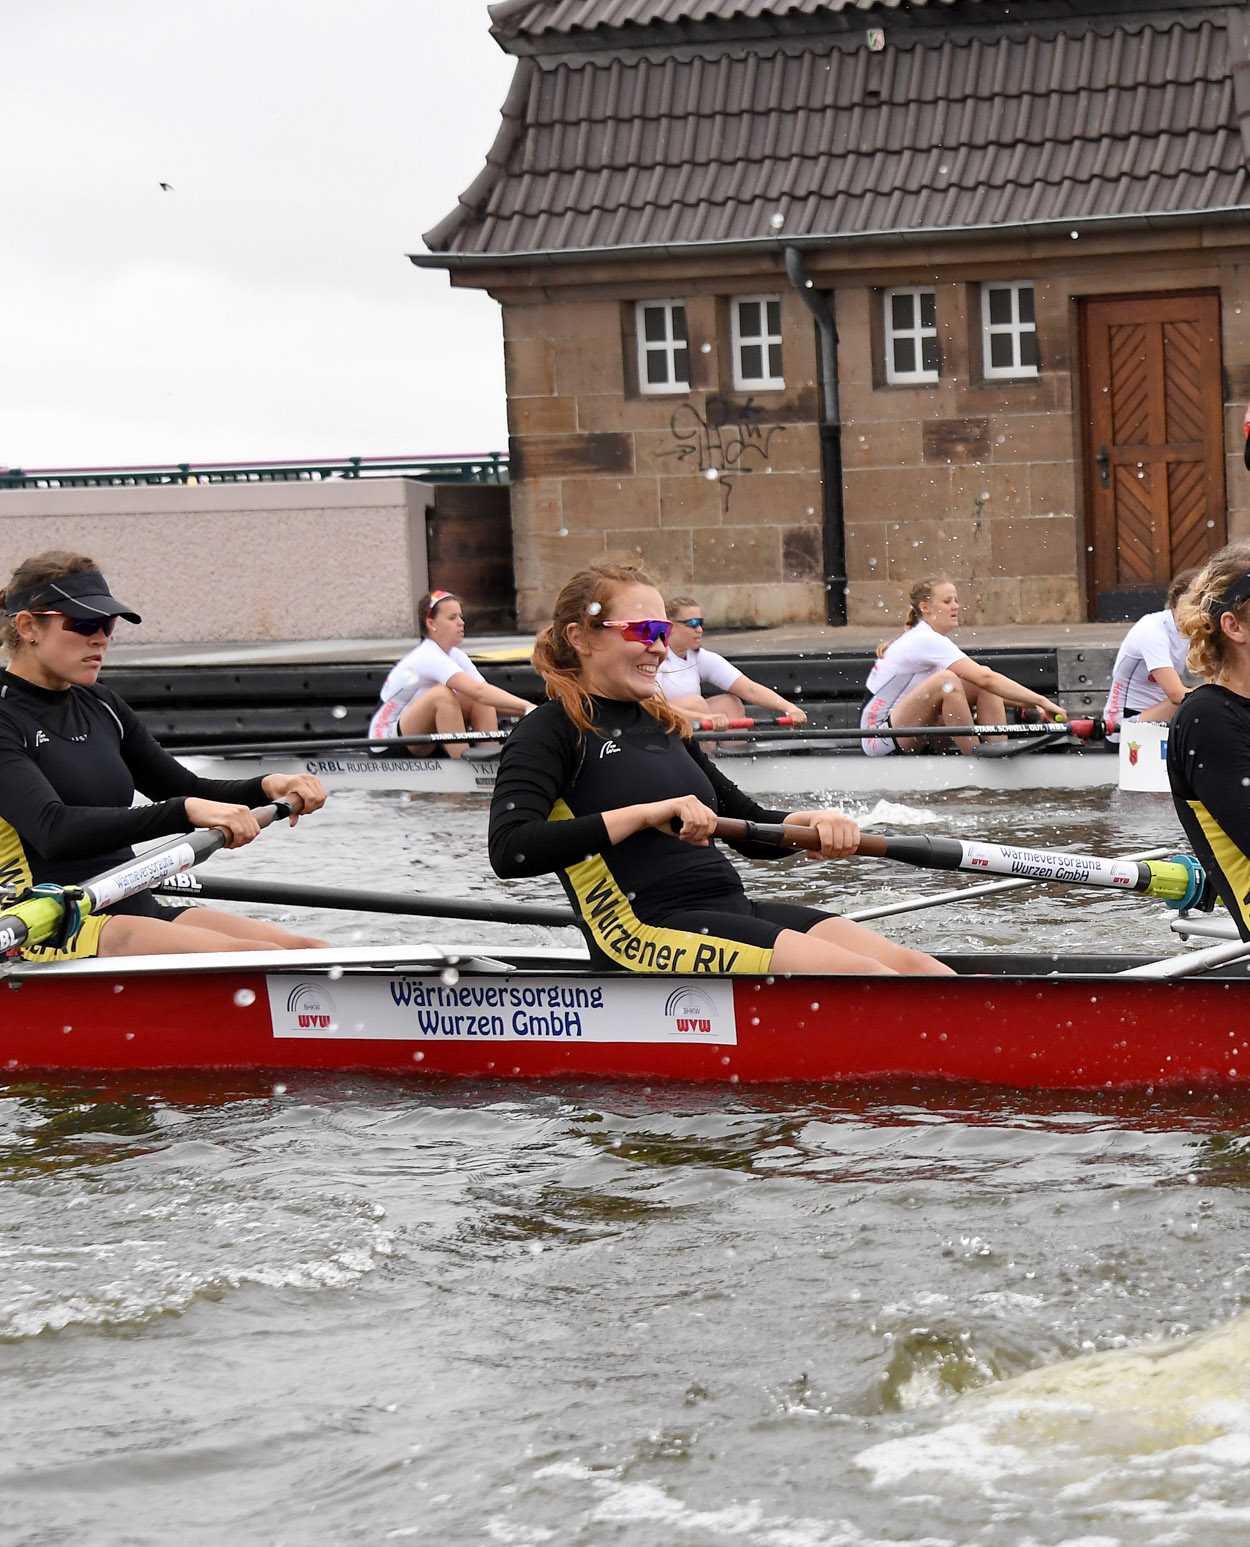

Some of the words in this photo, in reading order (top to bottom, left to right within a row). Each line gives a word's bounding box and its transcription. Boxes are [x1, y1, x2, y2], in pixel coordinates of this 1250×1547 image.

[974, 724, 998, 733] STARK.
[999, 724, 1029, 732] SCHNELL.
[1029, 723, 1046, 731] GUT.
[319, 761, 345, 772] RBL
[347, 760, 443, 773] RUDER-BUNDESLIGA
[1000, 846, 1102, 871] Wärmeversorgung
[1011, 860, 1053, 877] Wurzen
[1055, 867, 1090, 882] GmbH
[585, 877, 687, 972] Wurzener
[693, 943, 739, 973] RV
[389, 981, 604, 1008] Wärmeversorgung
[298, 1015, 331, 1028] WVW
[417, 1010, 505, 1036] Wurzen
[512, 1010, 583, 1037] GmbH
[676, 1018, 711, 1033] WVW
